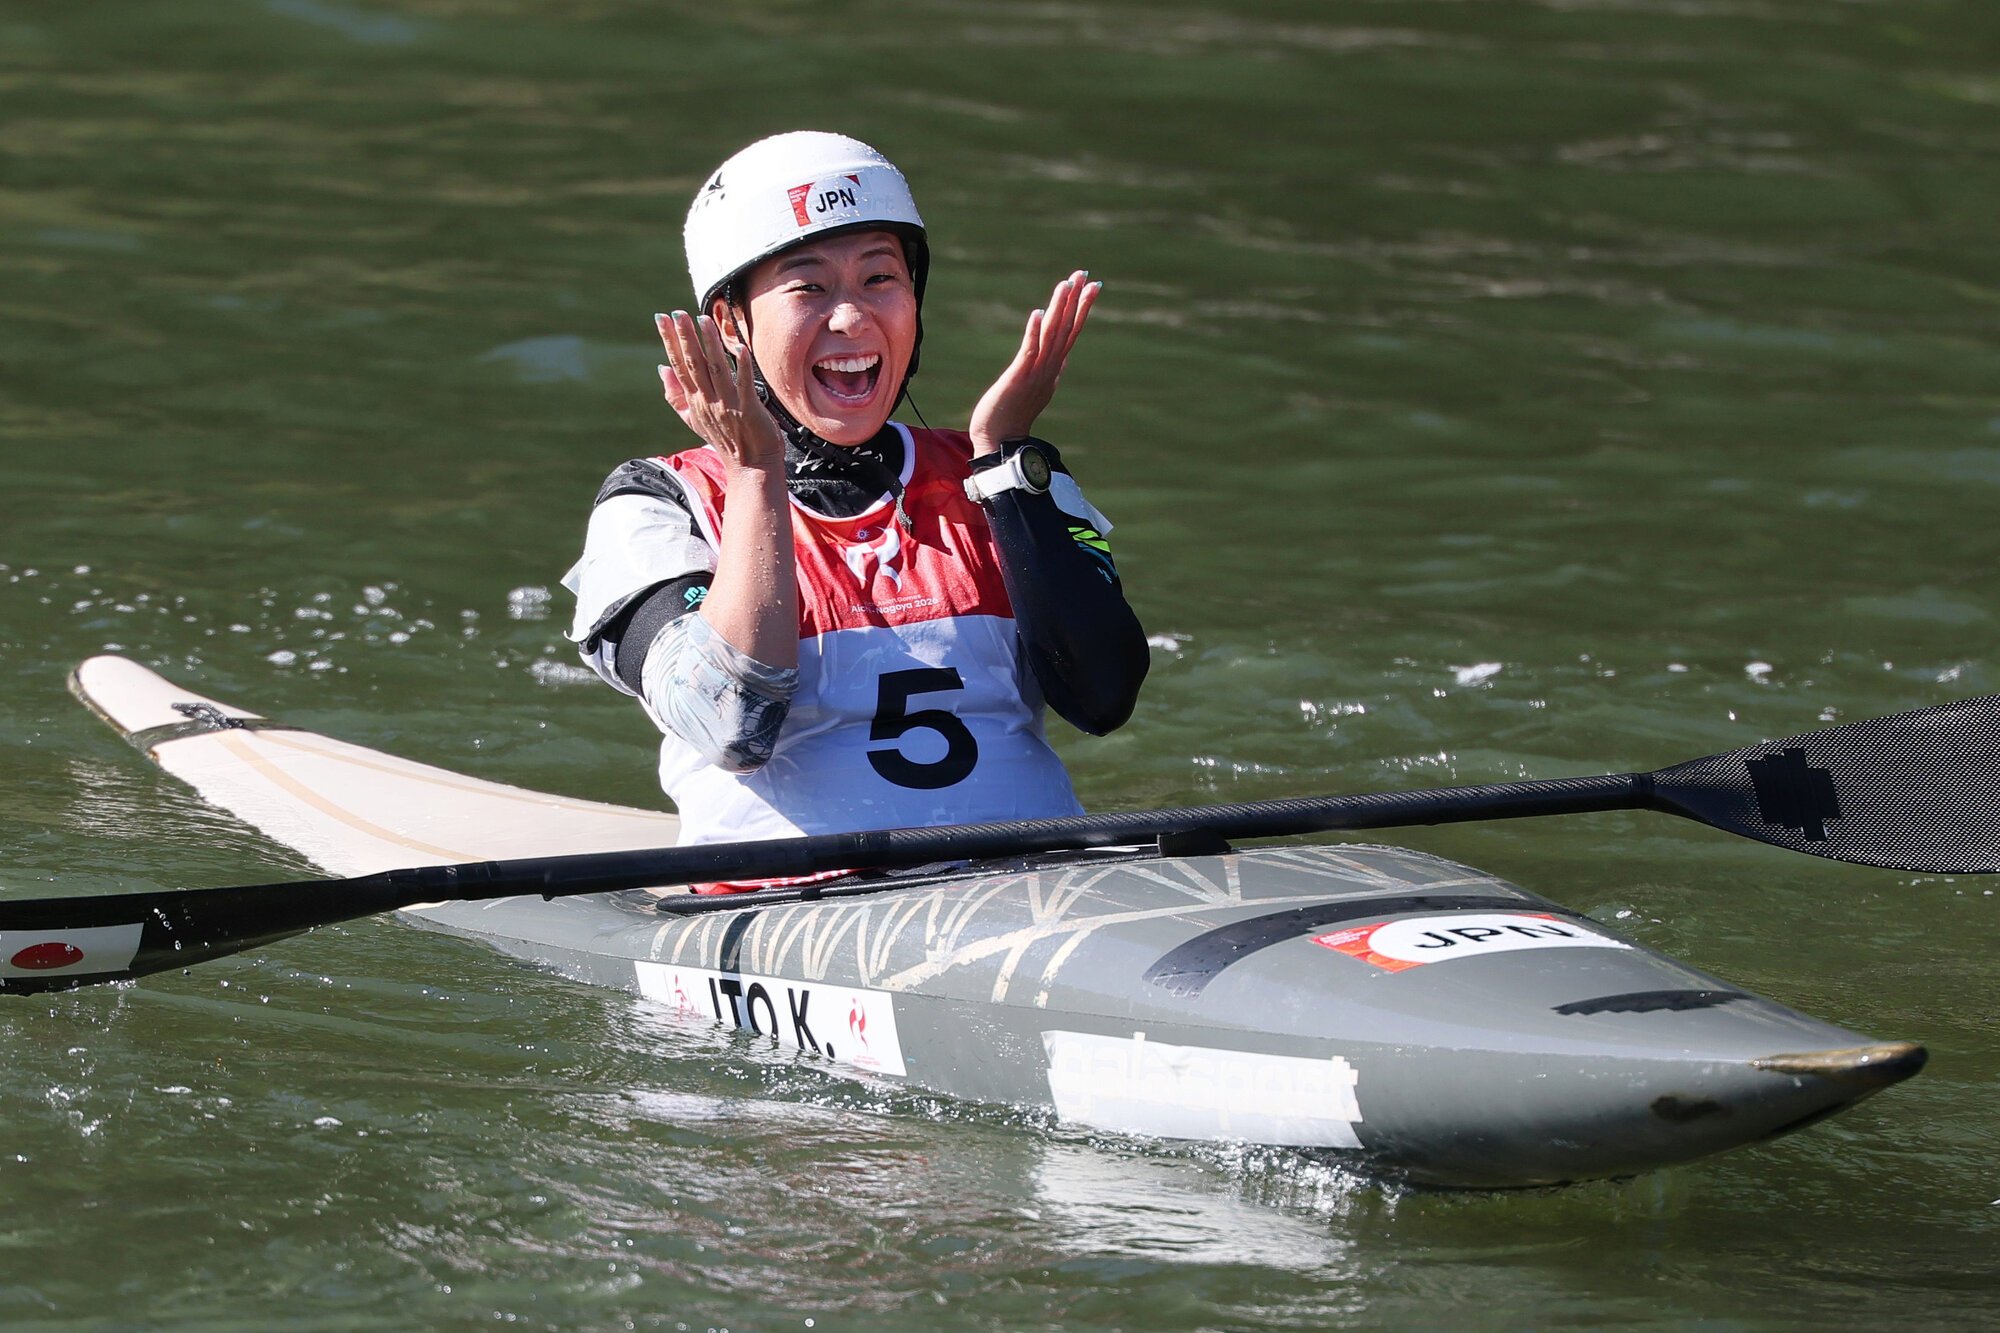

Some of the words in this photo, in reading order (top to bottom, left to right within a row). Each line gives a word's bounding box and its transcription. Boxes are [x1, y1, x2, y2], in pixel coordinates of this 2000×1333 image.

[816, 188, 856, 213] JPN
[914, 598, 939, 608] 2026
[867, 667, 979, 789] 5
[1414, 924, 1577, 949] JPN
[708, 977, 779, 1040] ITO
[788, 987, 835, 1059] K.
